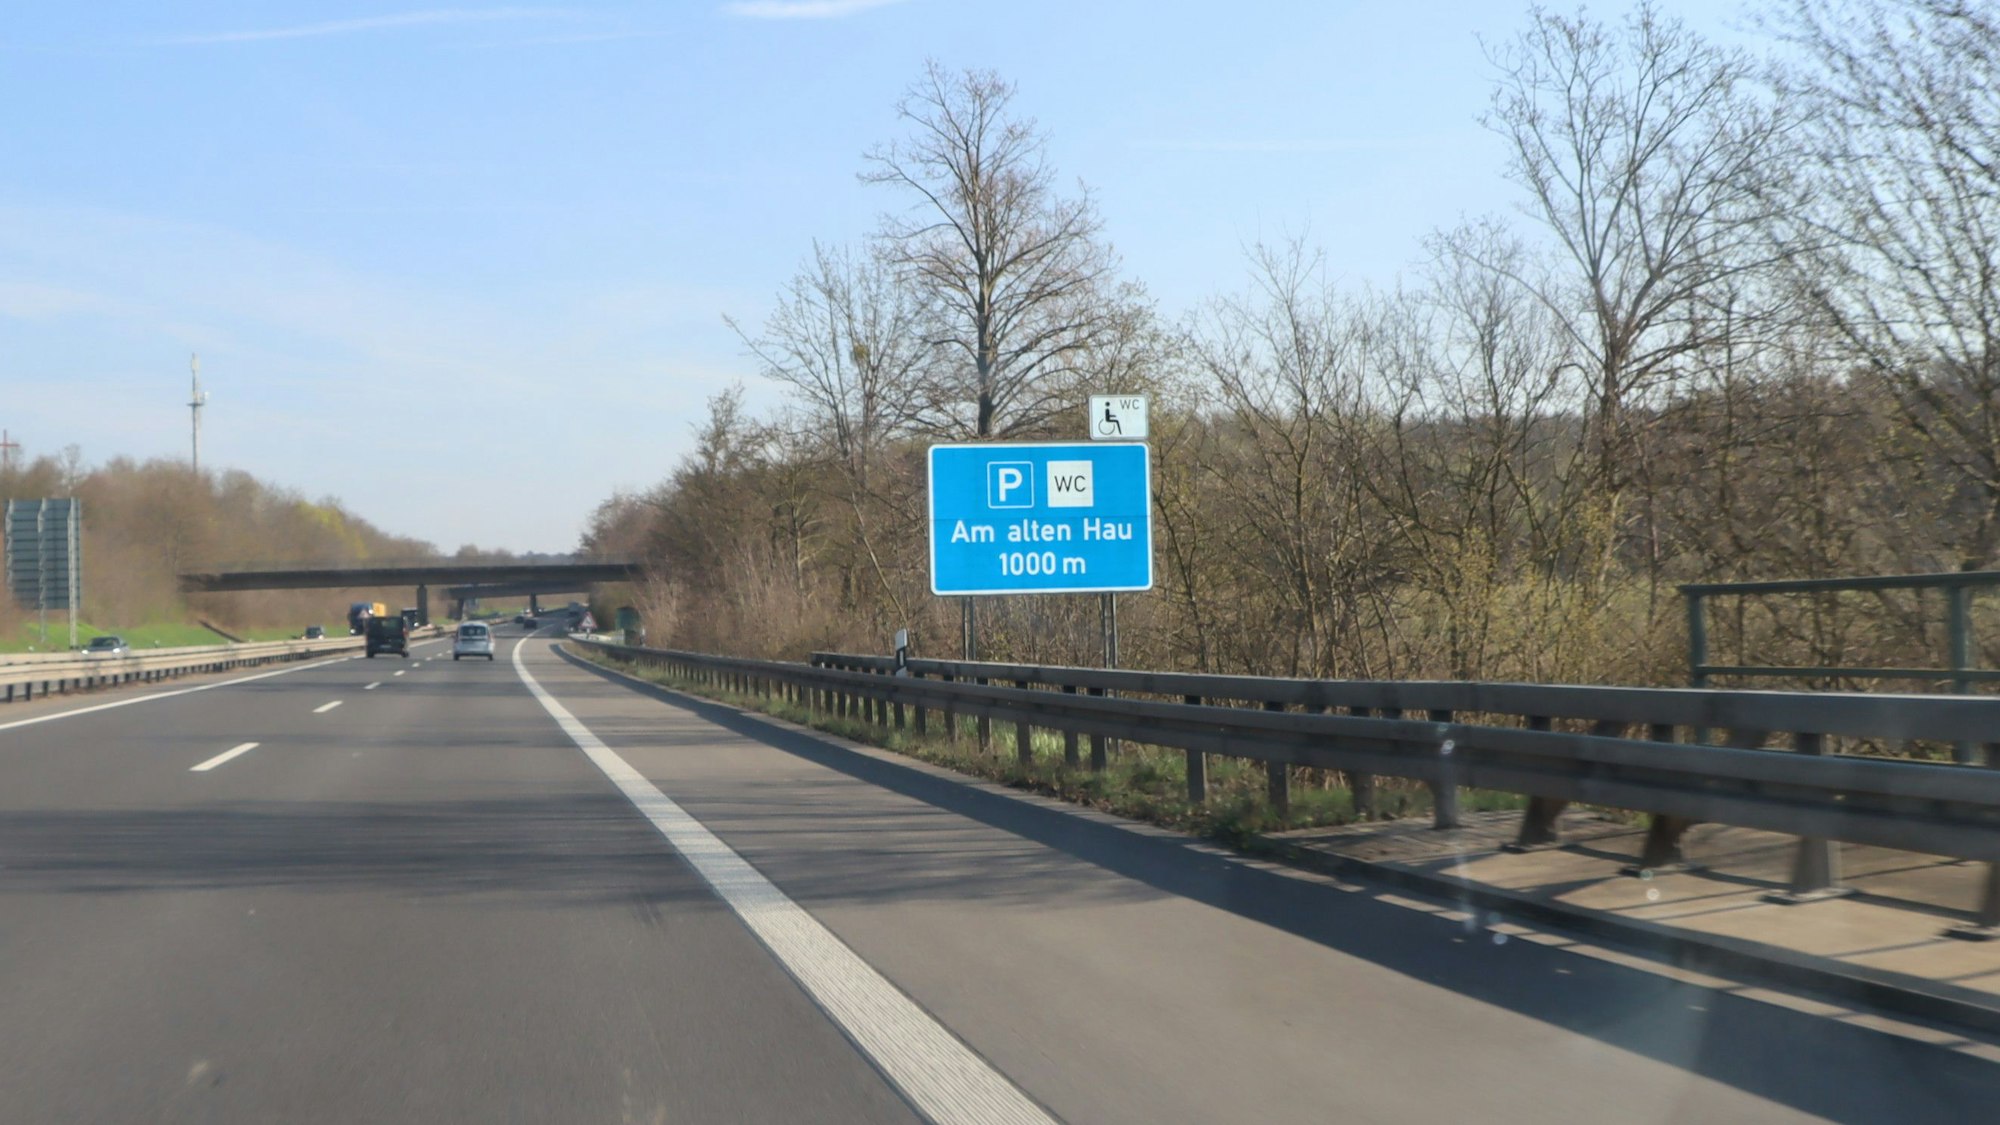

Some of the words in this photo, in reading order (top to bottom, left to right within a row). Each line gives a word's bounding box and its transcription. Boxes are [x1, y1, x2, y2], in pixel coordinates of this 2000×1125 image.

[1119, 399, 1139, 410] WC
[998, 468, 1022, 501] P
[1054, 475, 1087, 493] WC
[950, 520, 995, 543] Am
[1007, 518, 1071, 542] alten
[1083, 517, 1132, 541] Hau
[999, 552, 1056, 575] 1000
[1063, 557, 1086, 575] m
